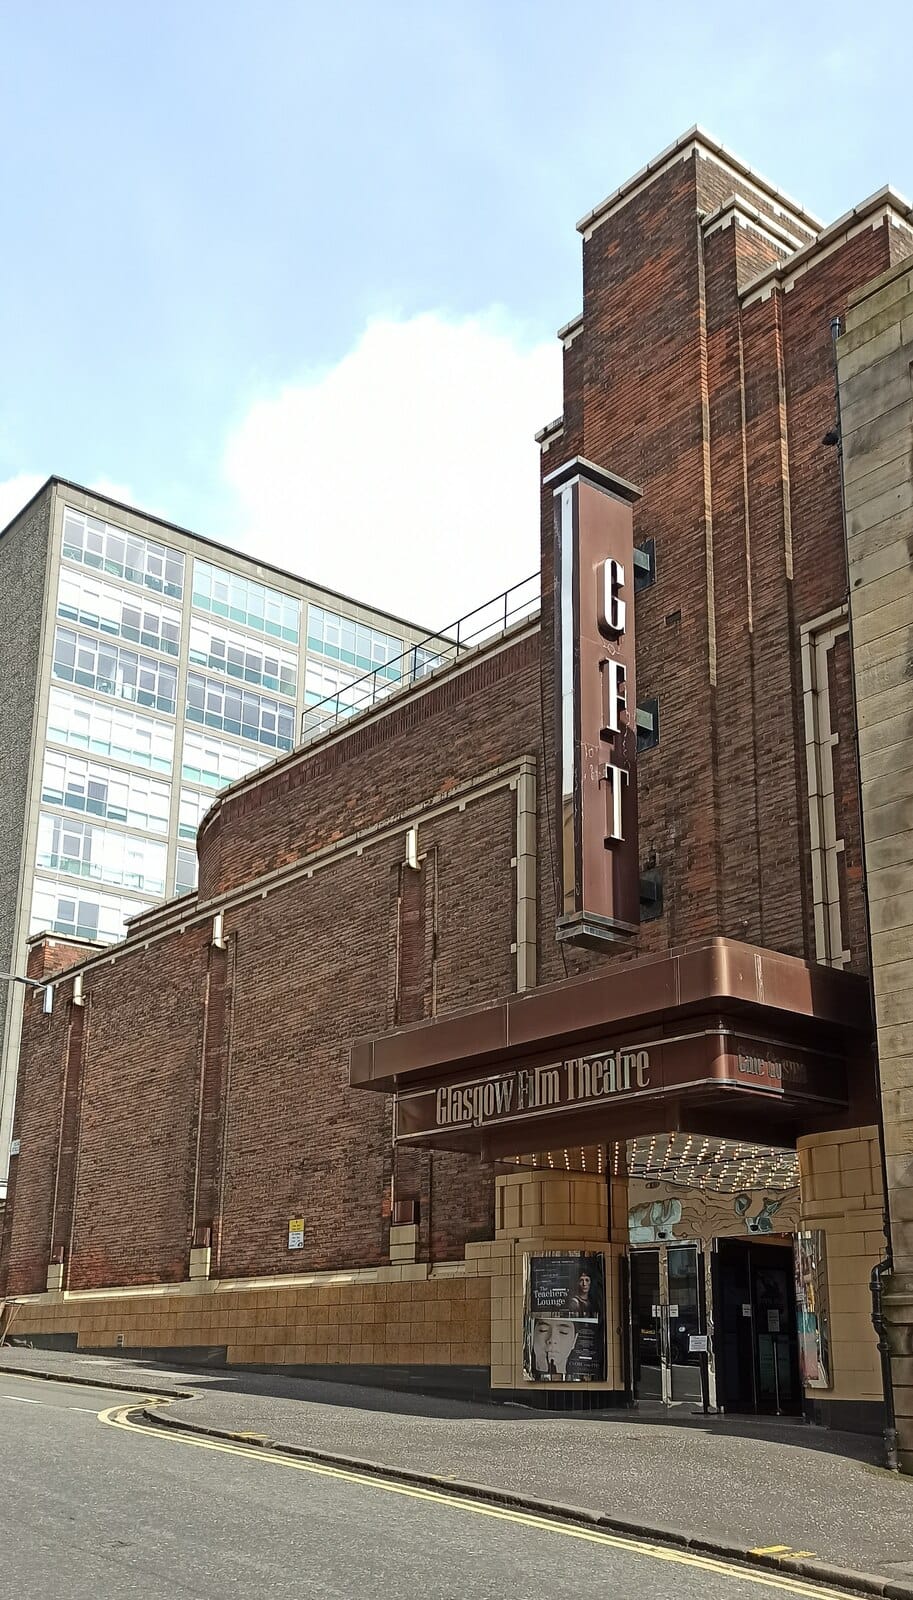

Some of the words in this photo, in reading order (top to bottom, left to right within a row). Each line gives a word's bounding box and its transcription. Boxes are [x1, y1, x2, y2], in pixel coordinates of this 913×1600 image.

[599, 557, 629, 843] GFT
[436, 1078, 514, 1127] Glasgow
[517, 1068, 560, 1111] Film
[564, 1050, 650, 1101] Theatre
[537, 1298, 566, 1306] Lounge
